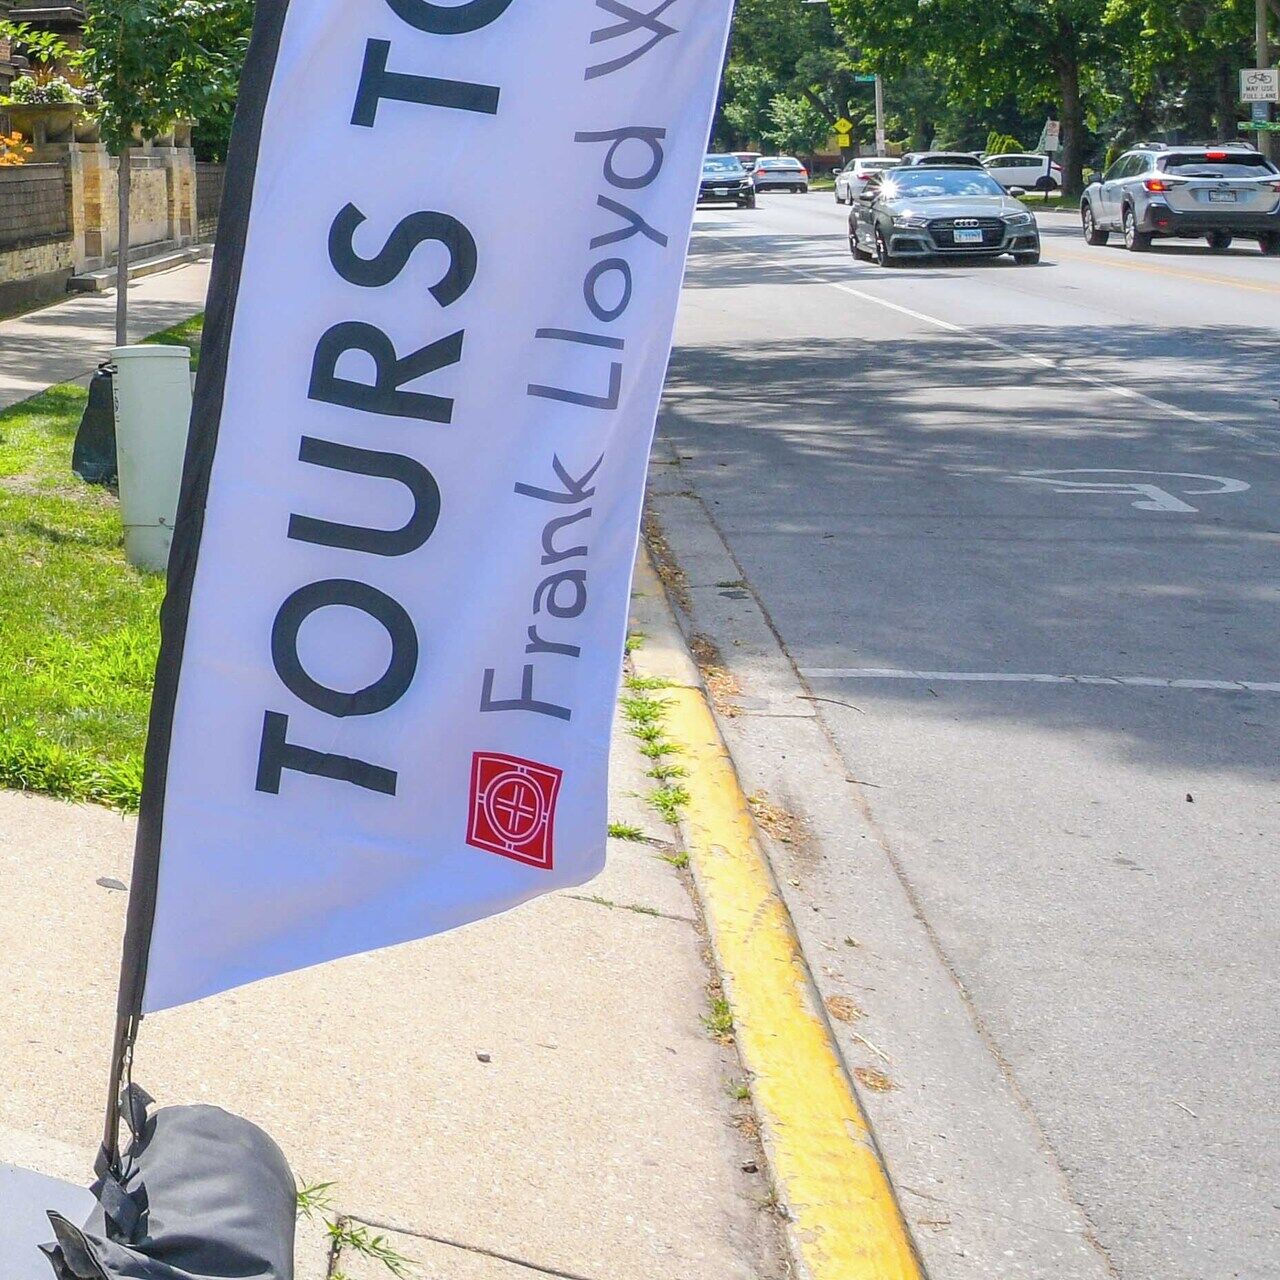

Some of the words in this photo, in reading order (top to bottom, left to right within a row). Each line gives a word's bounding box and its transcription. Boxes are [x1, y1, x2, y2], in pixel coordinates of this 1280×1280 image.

[527, 124, 669, 410] Lloyd
[255, 201, 477, 796] TOURS
[480, 452, 603, 720] Frank
